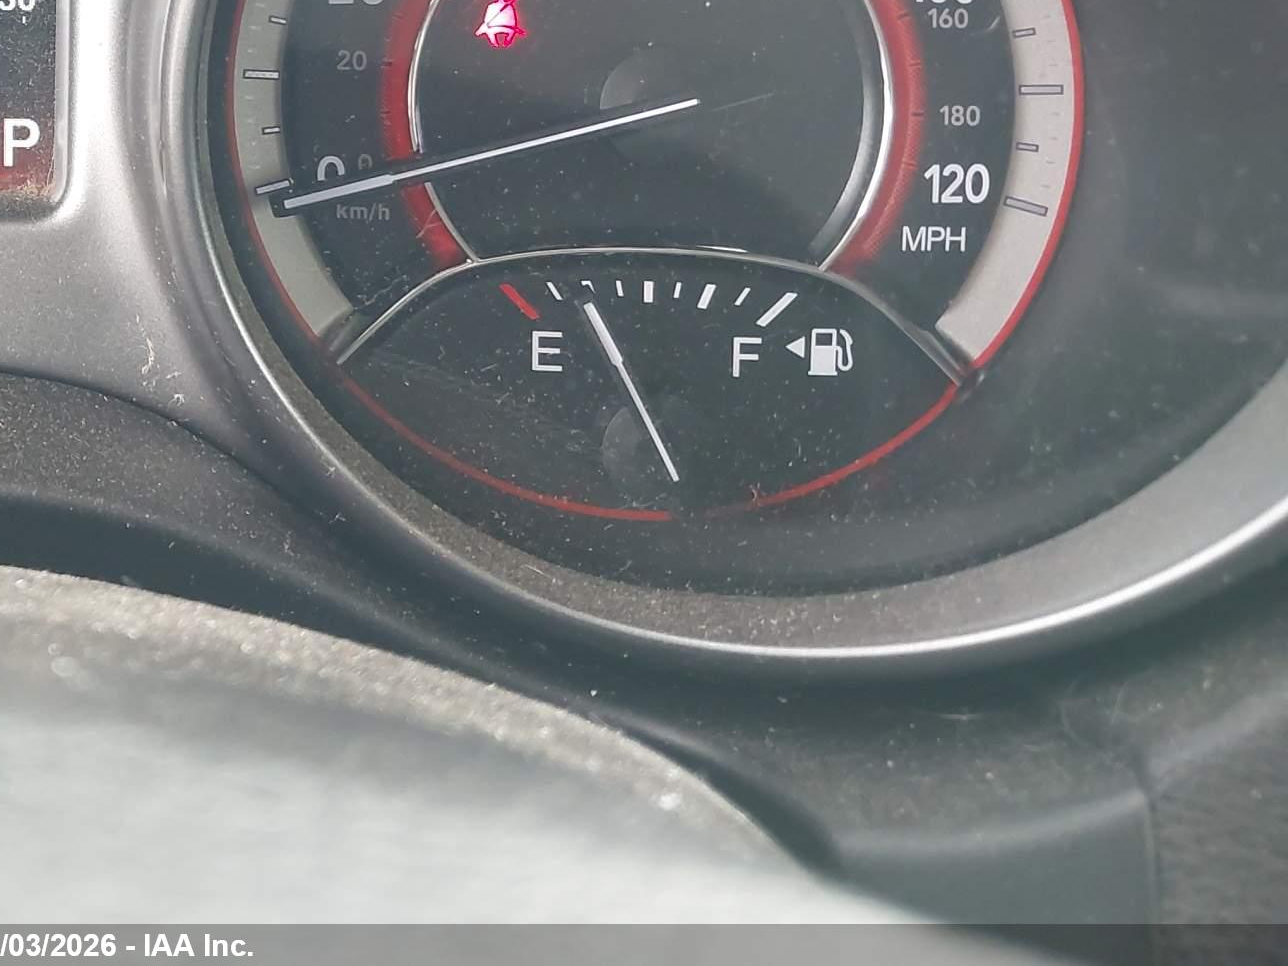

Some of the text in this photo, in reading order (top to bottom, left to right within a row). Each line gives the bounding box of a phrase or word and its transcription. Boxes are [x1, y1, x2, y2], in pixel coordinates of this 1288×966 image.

[928, 9, 968, 29] 160
[337, 51, 367, 71] 20
[940, 106, 981, 126] 180
[3, 118, 41, 166] P
[924, 164, 990, 204] 120
[336, 203, 390, 221] km/h
[902, 226, 966, 252] MPH
[531, 331, 563, 371] E
[732, 336, 762, 377] F
